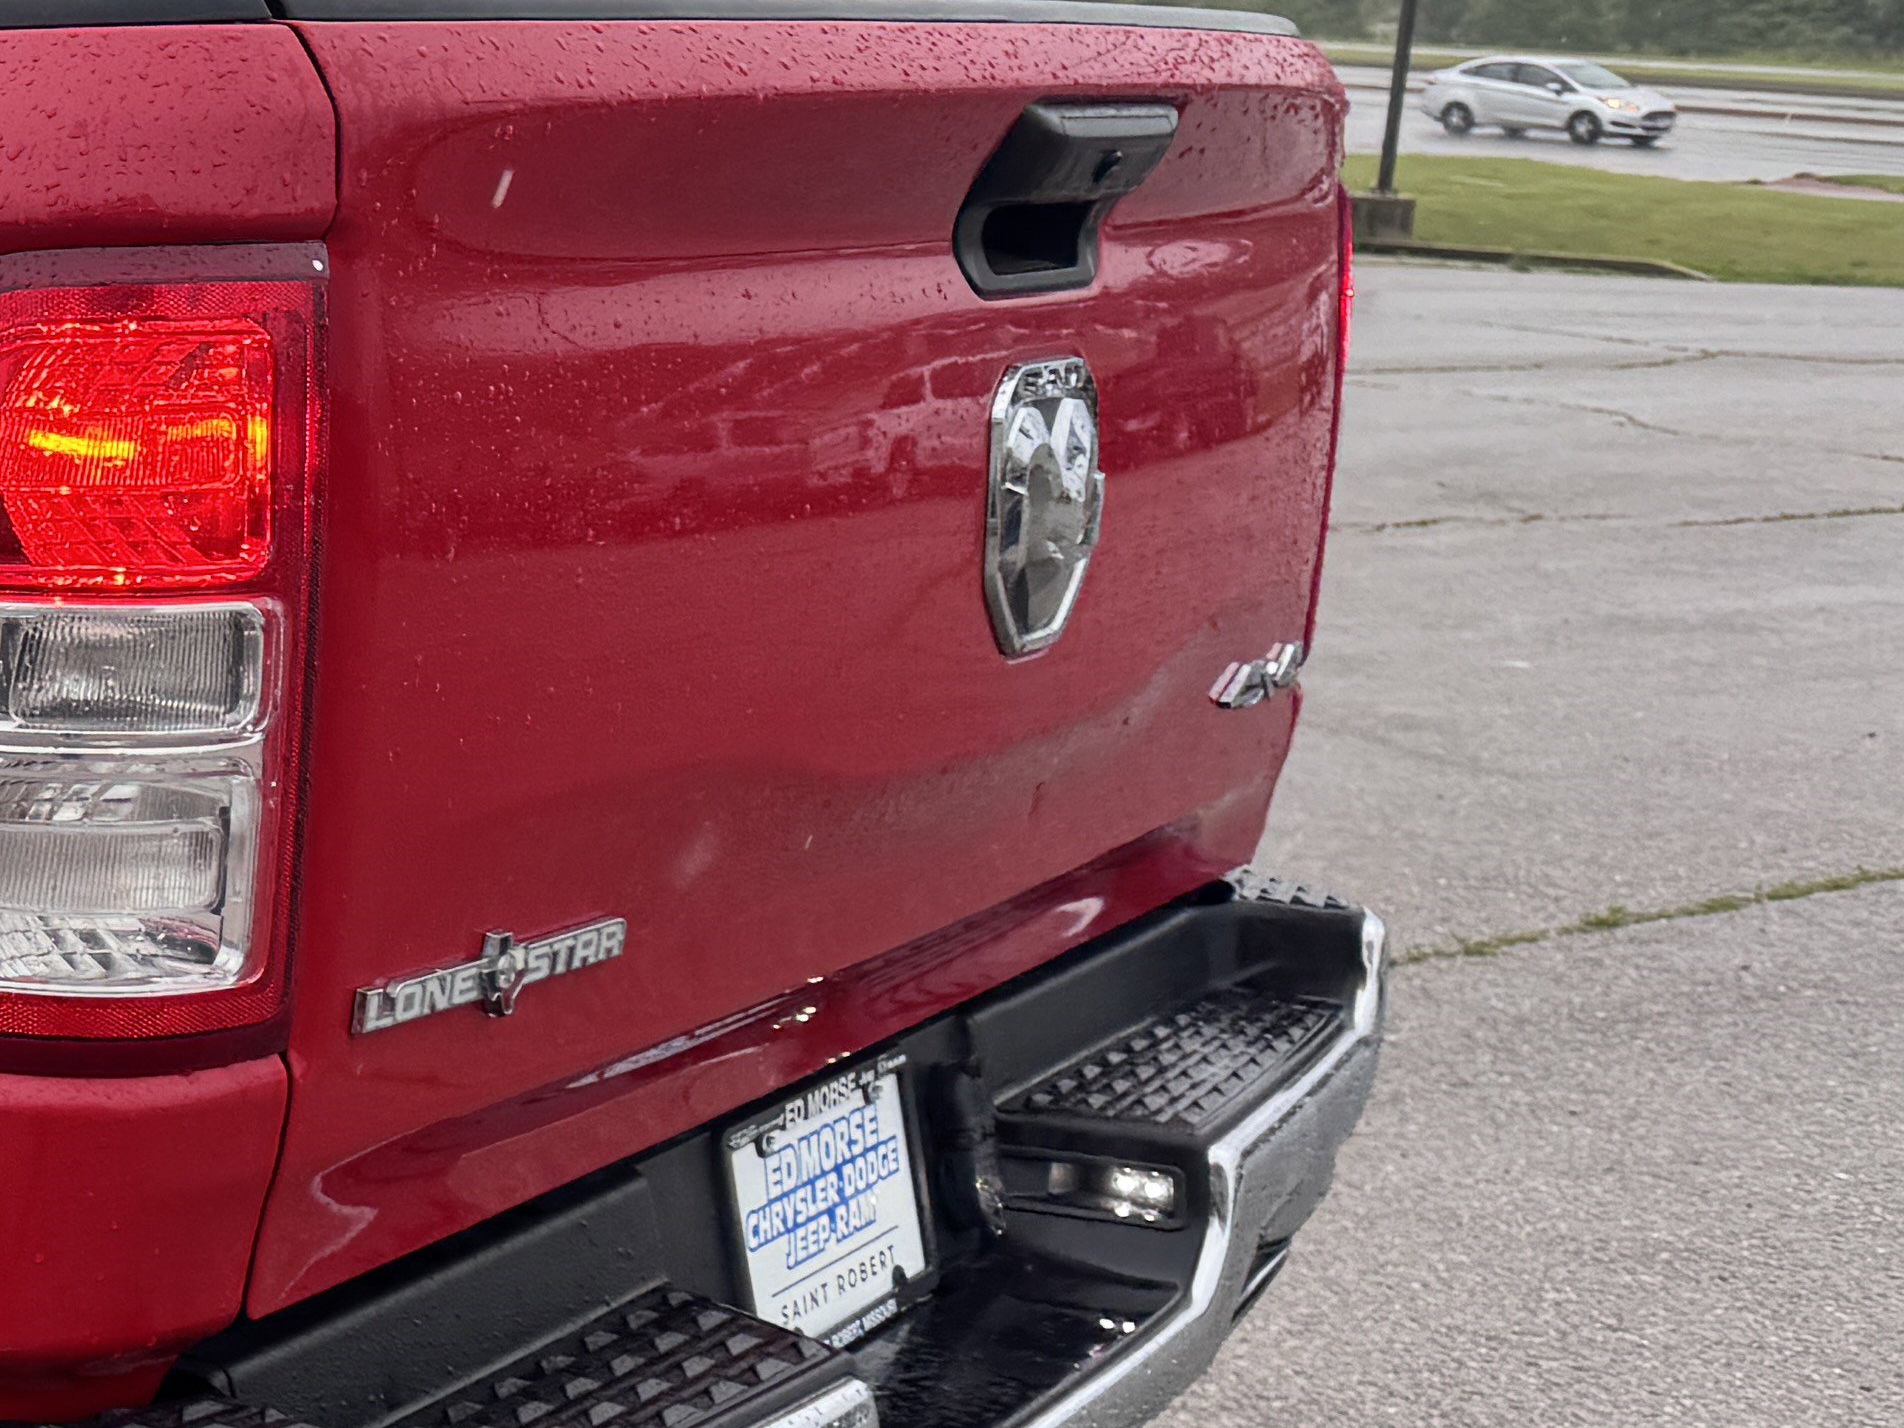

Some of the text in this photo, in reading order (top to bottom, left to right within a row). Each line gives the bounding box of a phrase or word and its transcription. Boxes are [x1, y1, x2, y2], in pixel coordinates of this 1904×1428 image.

[352, 921, 627, 1035] LONE STAR
[765, 1143, 797, 1200] ED
[797, 1104, 879, 1184] MORSE
[781, 1244, 895, 1327] SAINT ROBERT
